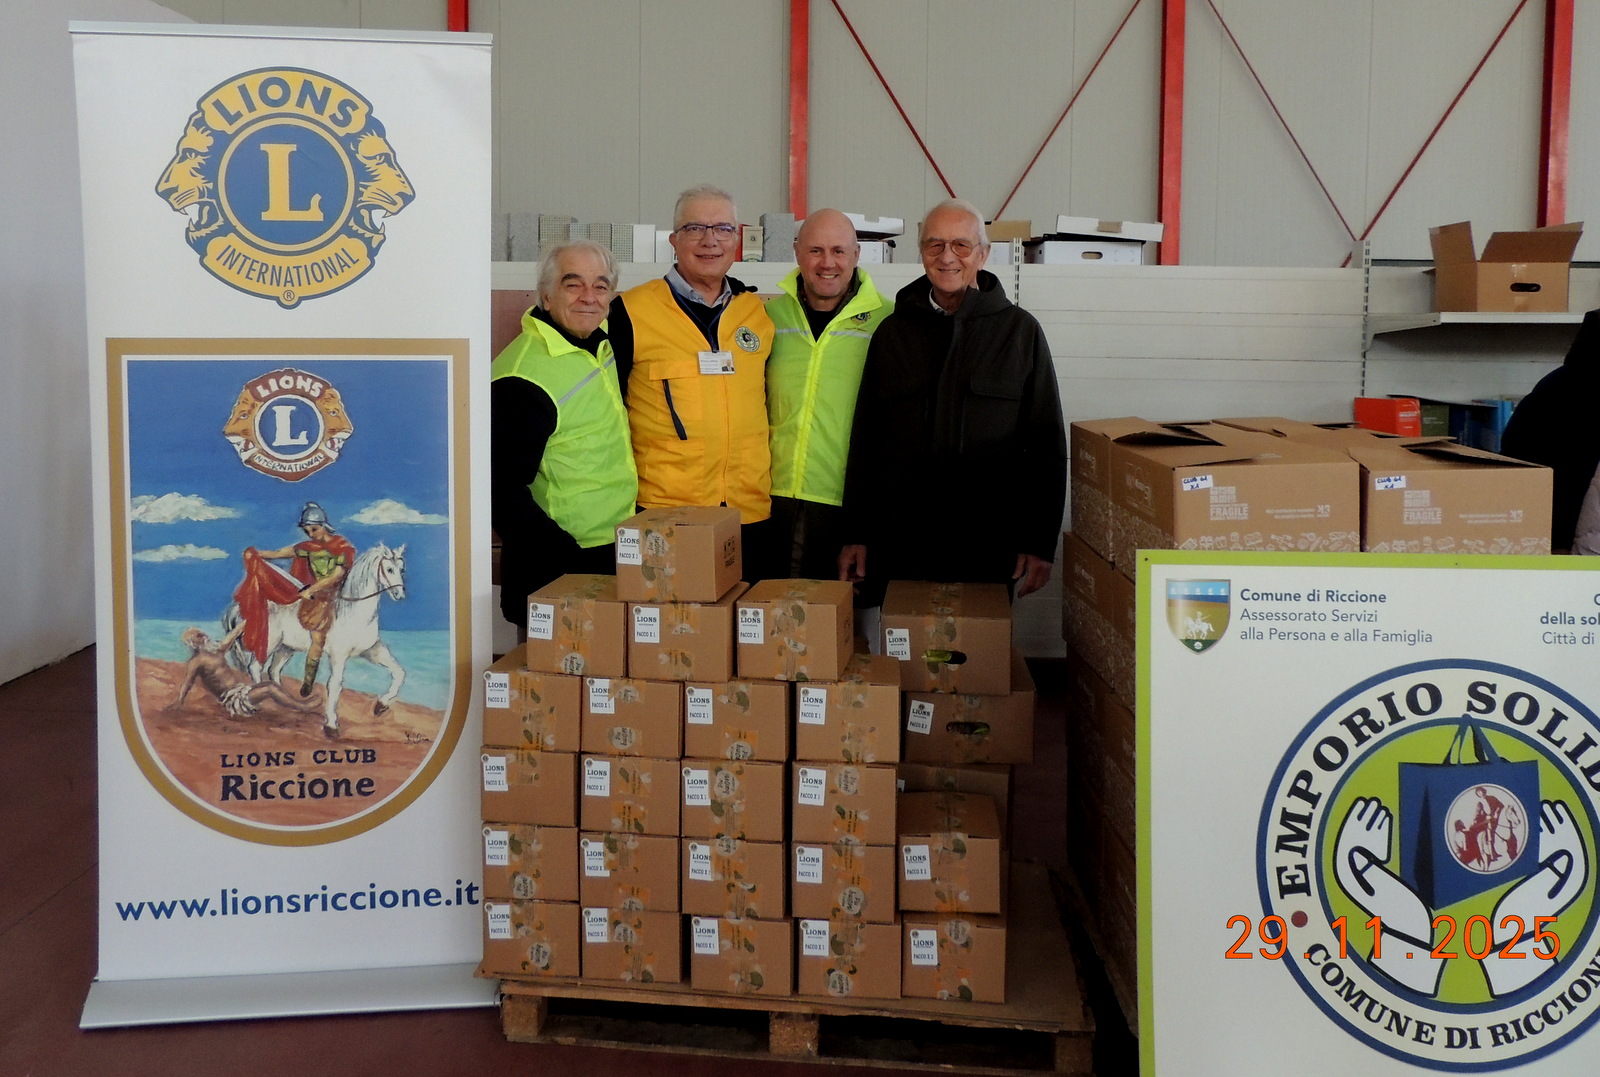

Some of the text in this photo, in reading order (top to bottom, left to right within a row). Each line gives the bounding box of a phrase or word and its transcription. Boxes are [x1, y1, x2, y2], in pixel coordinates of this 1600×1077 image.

[211, 76, 359, 135] LIONS
[260, 143, 324, 221] L
[216, 244, 359, 287] INTERNATIONAL
[256, 375, 323, 398] LIONS
[272, 405, 309, 447] L
[1210, 507, 1248, 517] FRAGILE
[1404, 511, 1442, 520] FRAGILE
[1240, 588, 1386, 602] Comune di Riccione
[1240, 608, 1378, 622] Assessorato Servizi
[1540, 612, 1576, 624] della
[1240, 627, 1433, 646] alla Persona e alla Famiglia
[1542, 632, 1594, 644] Città di
[220, 749, 377, 768] LIONS CLUB
[220, 773, 376, 801] Riccione
[1275, 682, 1443, 899] EMPORIO
[116, 879, 480, 921] www.lionsriccione.it
[1306, 943, 1600, 1050] COMUNE DI RICCION
